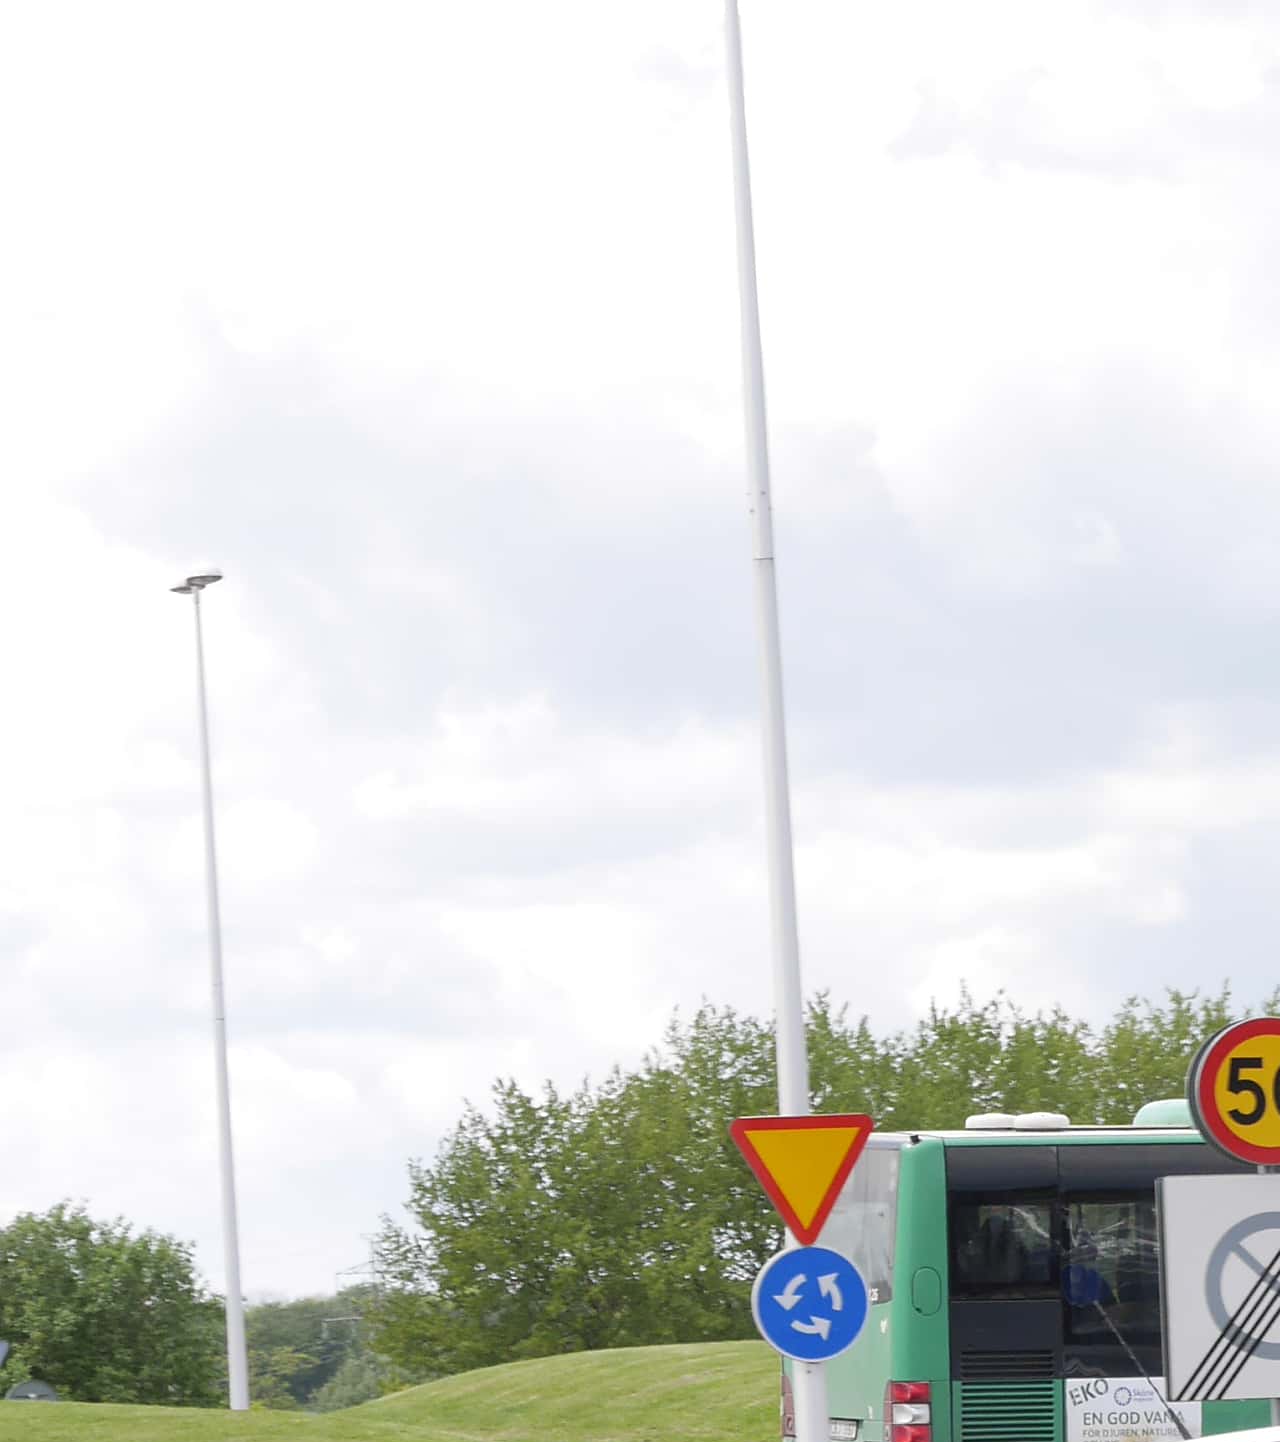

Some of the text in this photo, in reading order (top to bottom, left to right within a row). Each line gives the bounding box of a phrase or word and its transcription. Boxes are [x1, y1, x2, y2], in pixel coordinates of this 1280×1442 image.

[1069, 1379, 1109, 1407] EKO
[1083, 1412, 1103, 1426] EN
[1107, 1412, 1140, 1425] GOD
